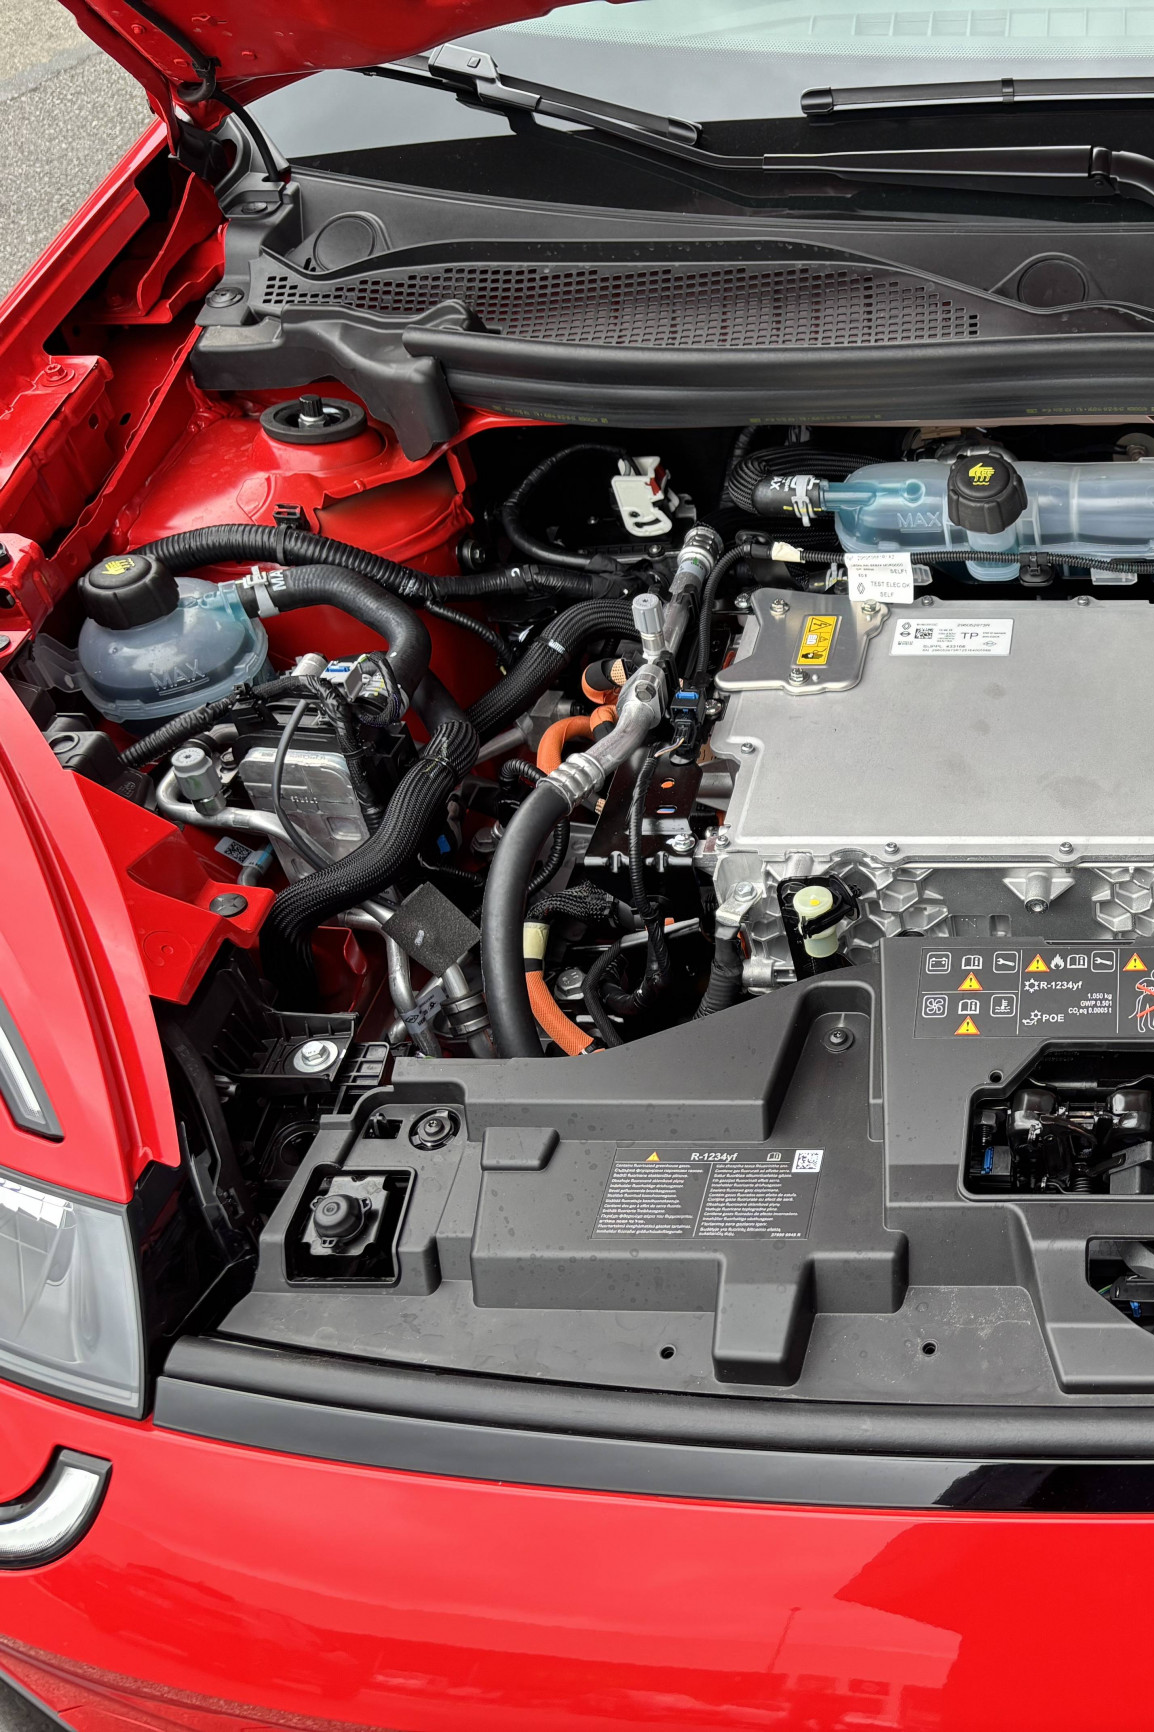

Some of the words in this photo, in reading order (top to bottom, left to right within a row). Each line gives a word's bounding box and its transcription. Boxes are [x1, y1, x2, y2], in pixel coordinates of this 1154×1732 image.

[896, 511, 942, 528] MAX
[151, 658, 206, 690] MAX
[1040, 981, 1082, 990] R-1234yf
[1043, 1014, 1064, 1022] POE
[690, 1152, 738, 1162] R-1234yf
